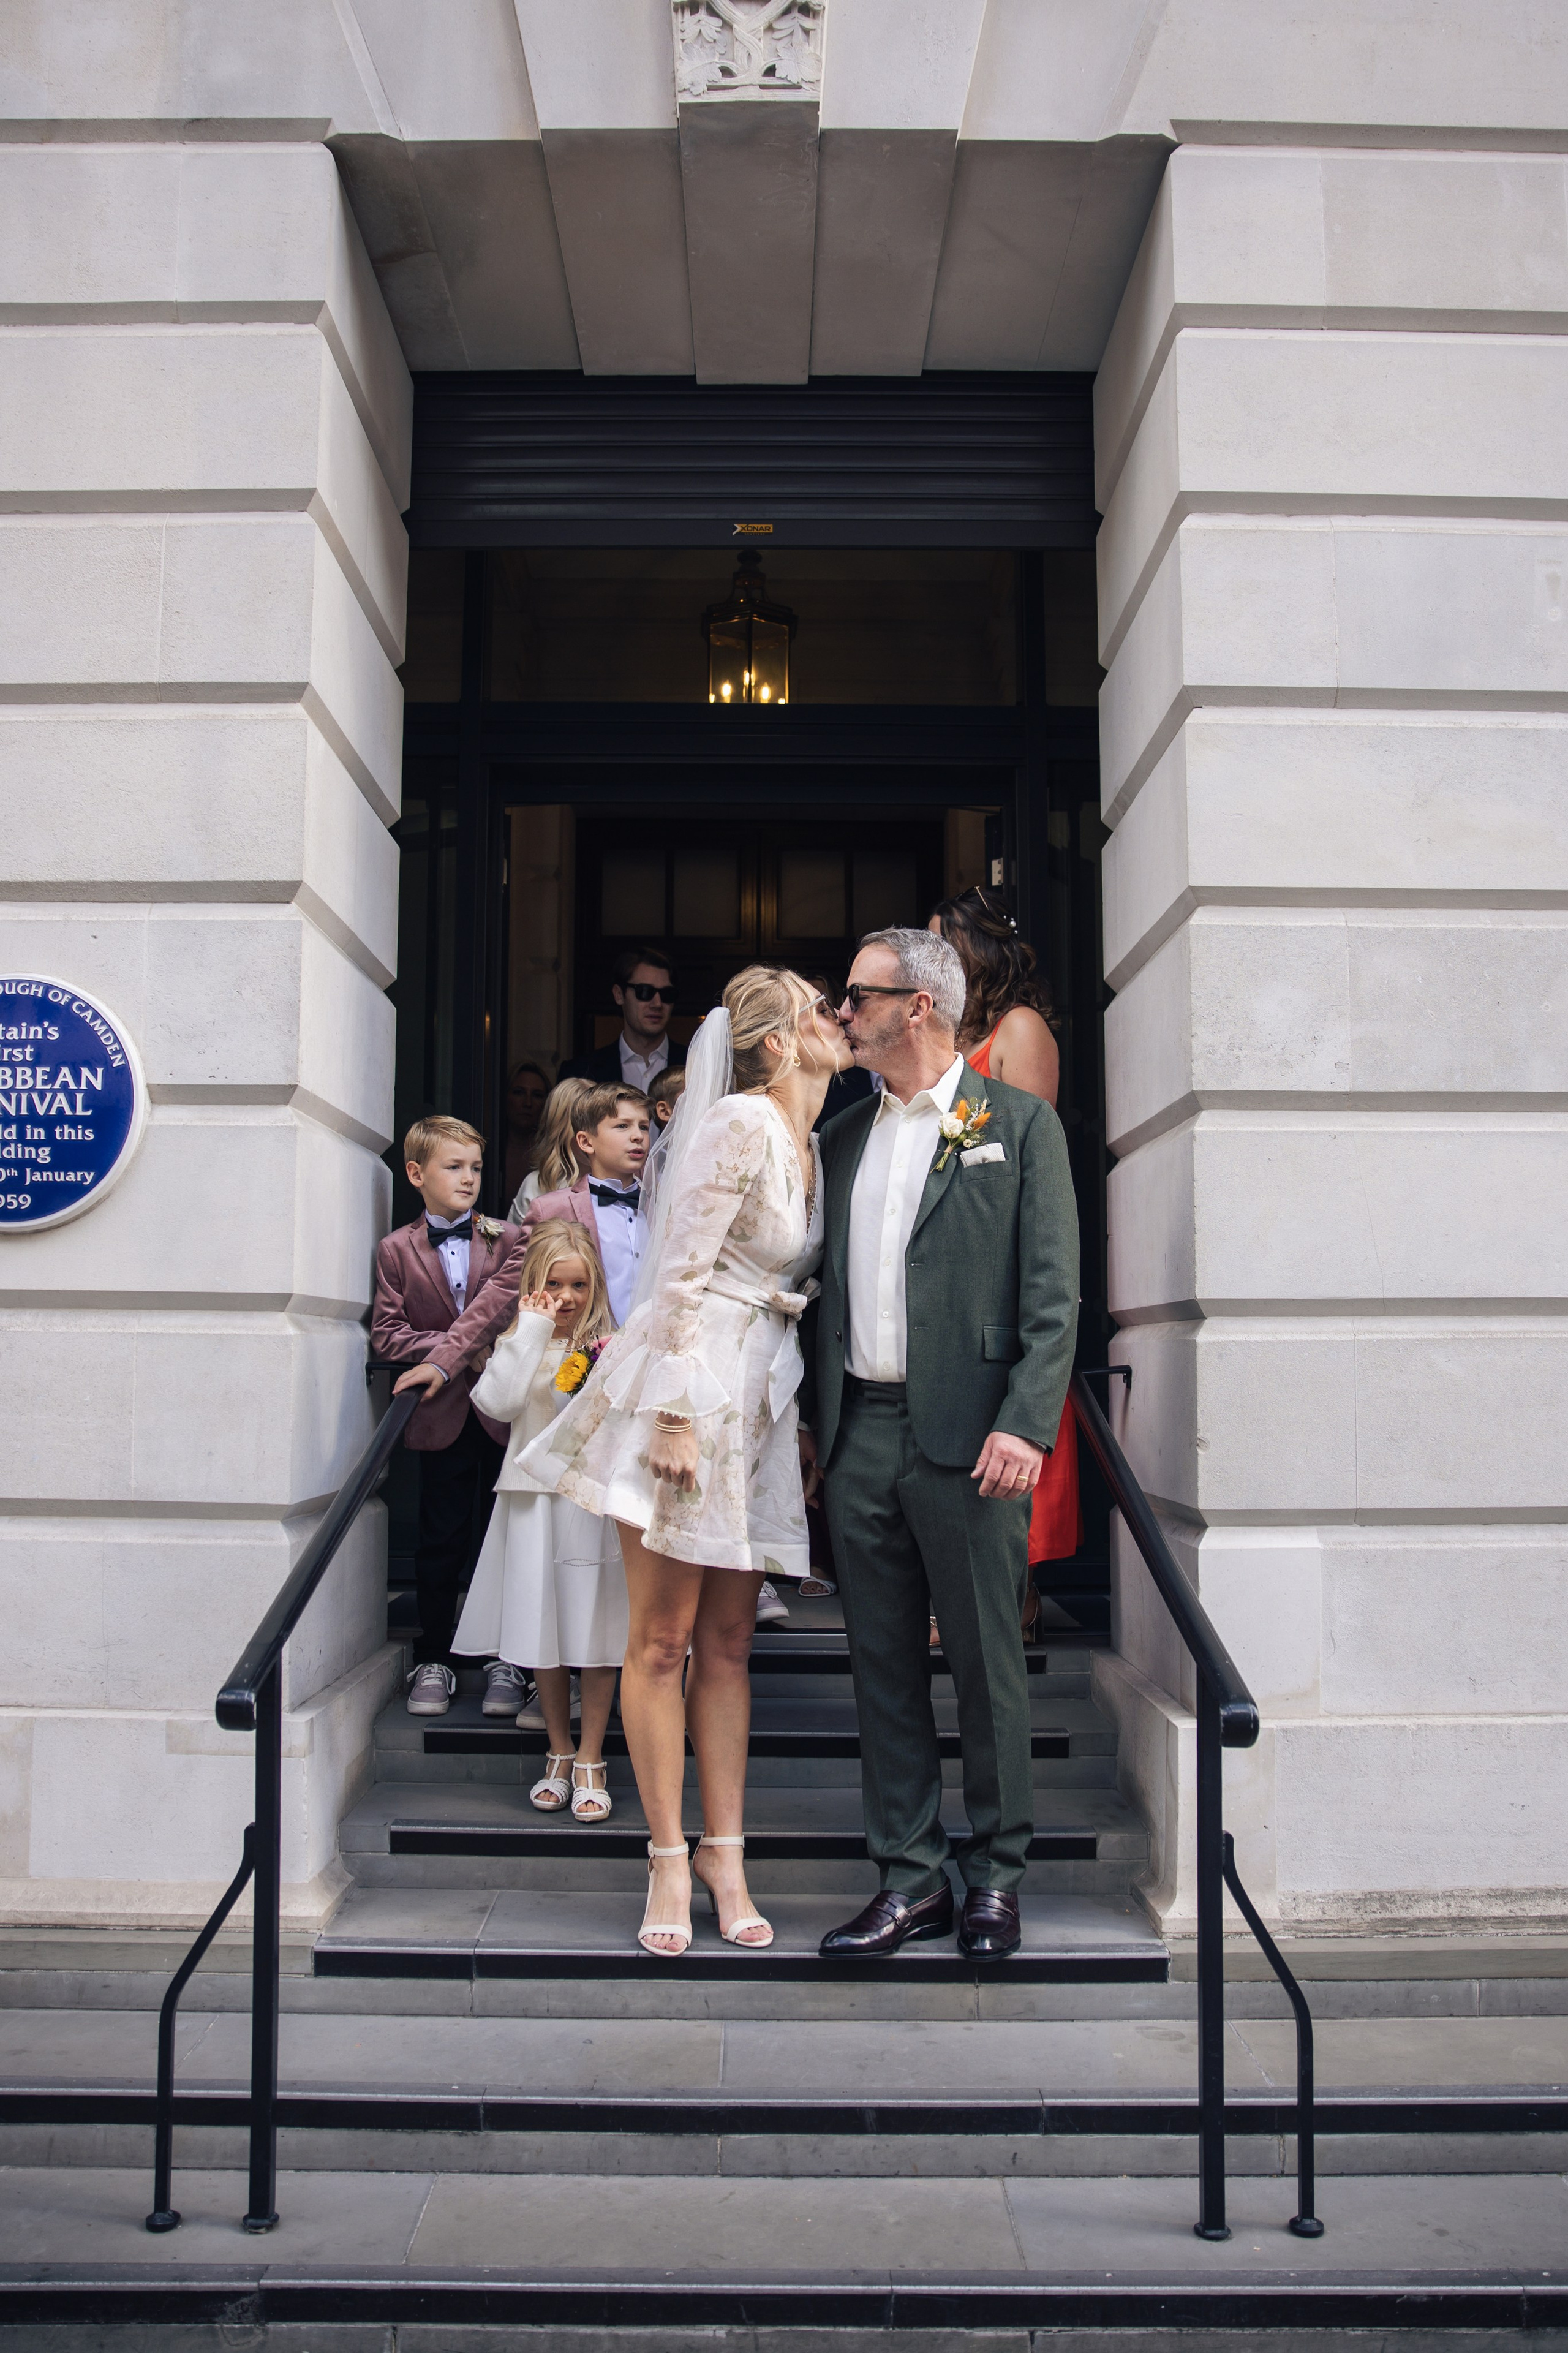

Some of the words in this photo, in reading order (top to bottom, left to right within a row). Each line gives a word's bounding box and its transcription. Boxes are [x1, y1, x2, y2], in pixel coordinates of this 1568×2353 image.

[739, 523, 771, 532] XONAR
[48, 989, 72, 1005] OF
[72, 1001, 126, 1068] CAMDEN
[0, 1044, 34, 1062] rst
[0, 1092, 92, 1116] NIVAL
[25, 1124, 46, 1140] in
[54, 1125, 94, 1141] this
[0, 1143, 51, 1163] ding
[24, 1168, 95, 1185] January
